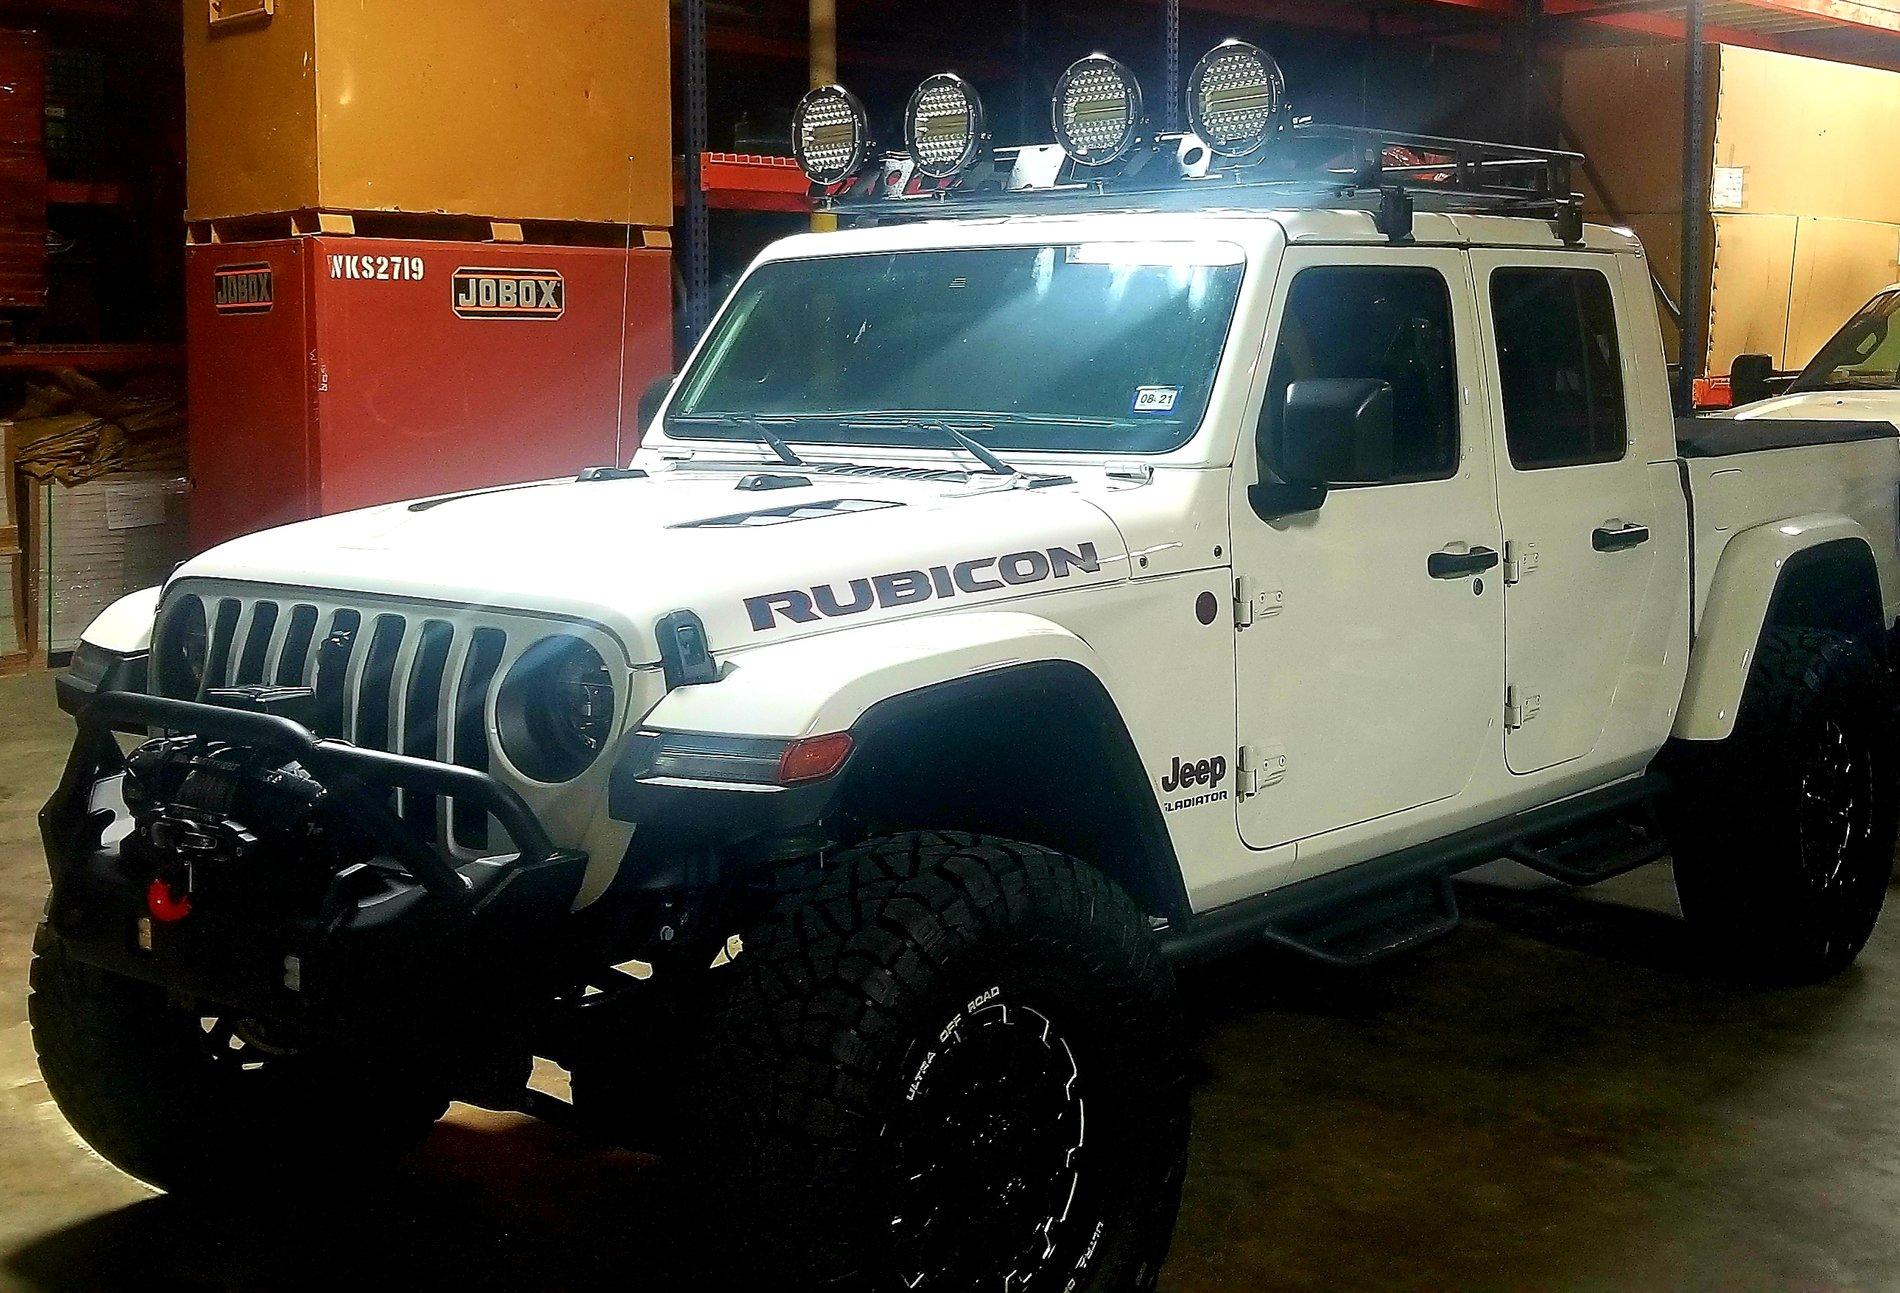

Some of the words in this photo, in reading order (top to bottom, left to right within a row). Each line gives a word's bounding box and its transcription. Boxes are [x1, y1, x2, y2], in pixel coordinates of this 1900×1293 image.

[326, 254, 424, 281] WKS2719
[217, 272, 271, 304] JOBOX
[458, 278, 559, 309] JOBOX
[743, 541, 1101, 632] RUBICON
[1161, 755, 1226, 792] Jeep
[906, 1052, 936, 1101] ULTRA
[939, 1013, 961, 1043] OFF
[967, 986, 1000, 1013] ROAD
